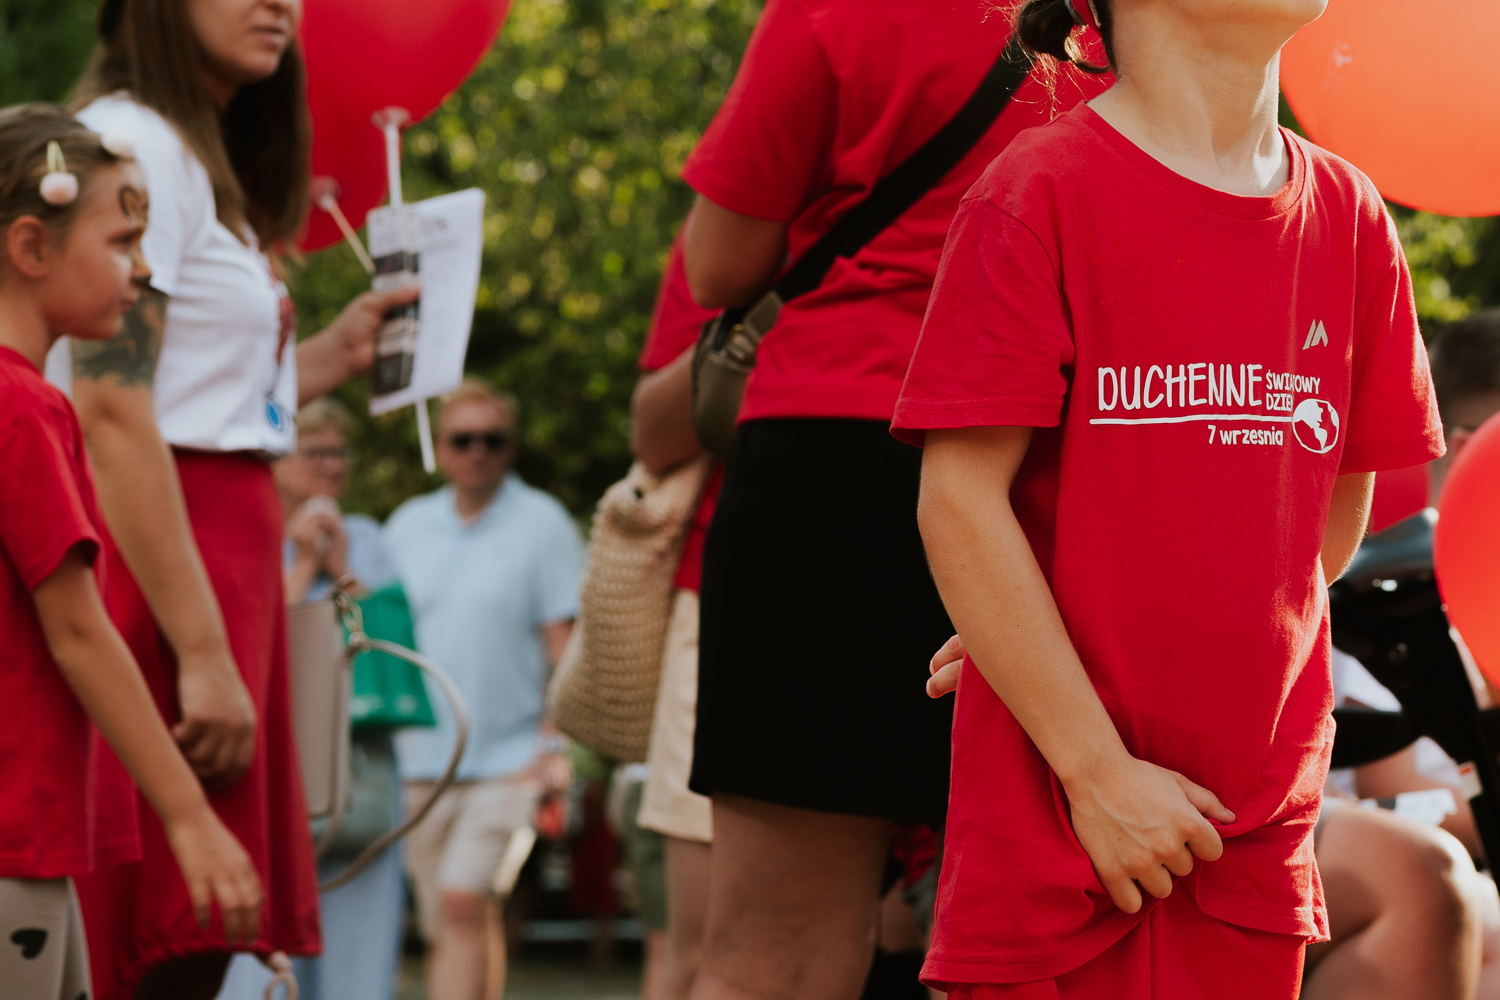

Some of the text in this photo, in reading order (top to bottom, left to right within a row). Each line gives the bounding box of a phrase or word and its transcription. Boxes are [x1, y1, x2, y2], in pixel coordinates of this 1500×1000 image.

[1098, 363, 1262, 411] DUCHENNE
[1207, 424, 1284, 446] 7 wrzesnia
